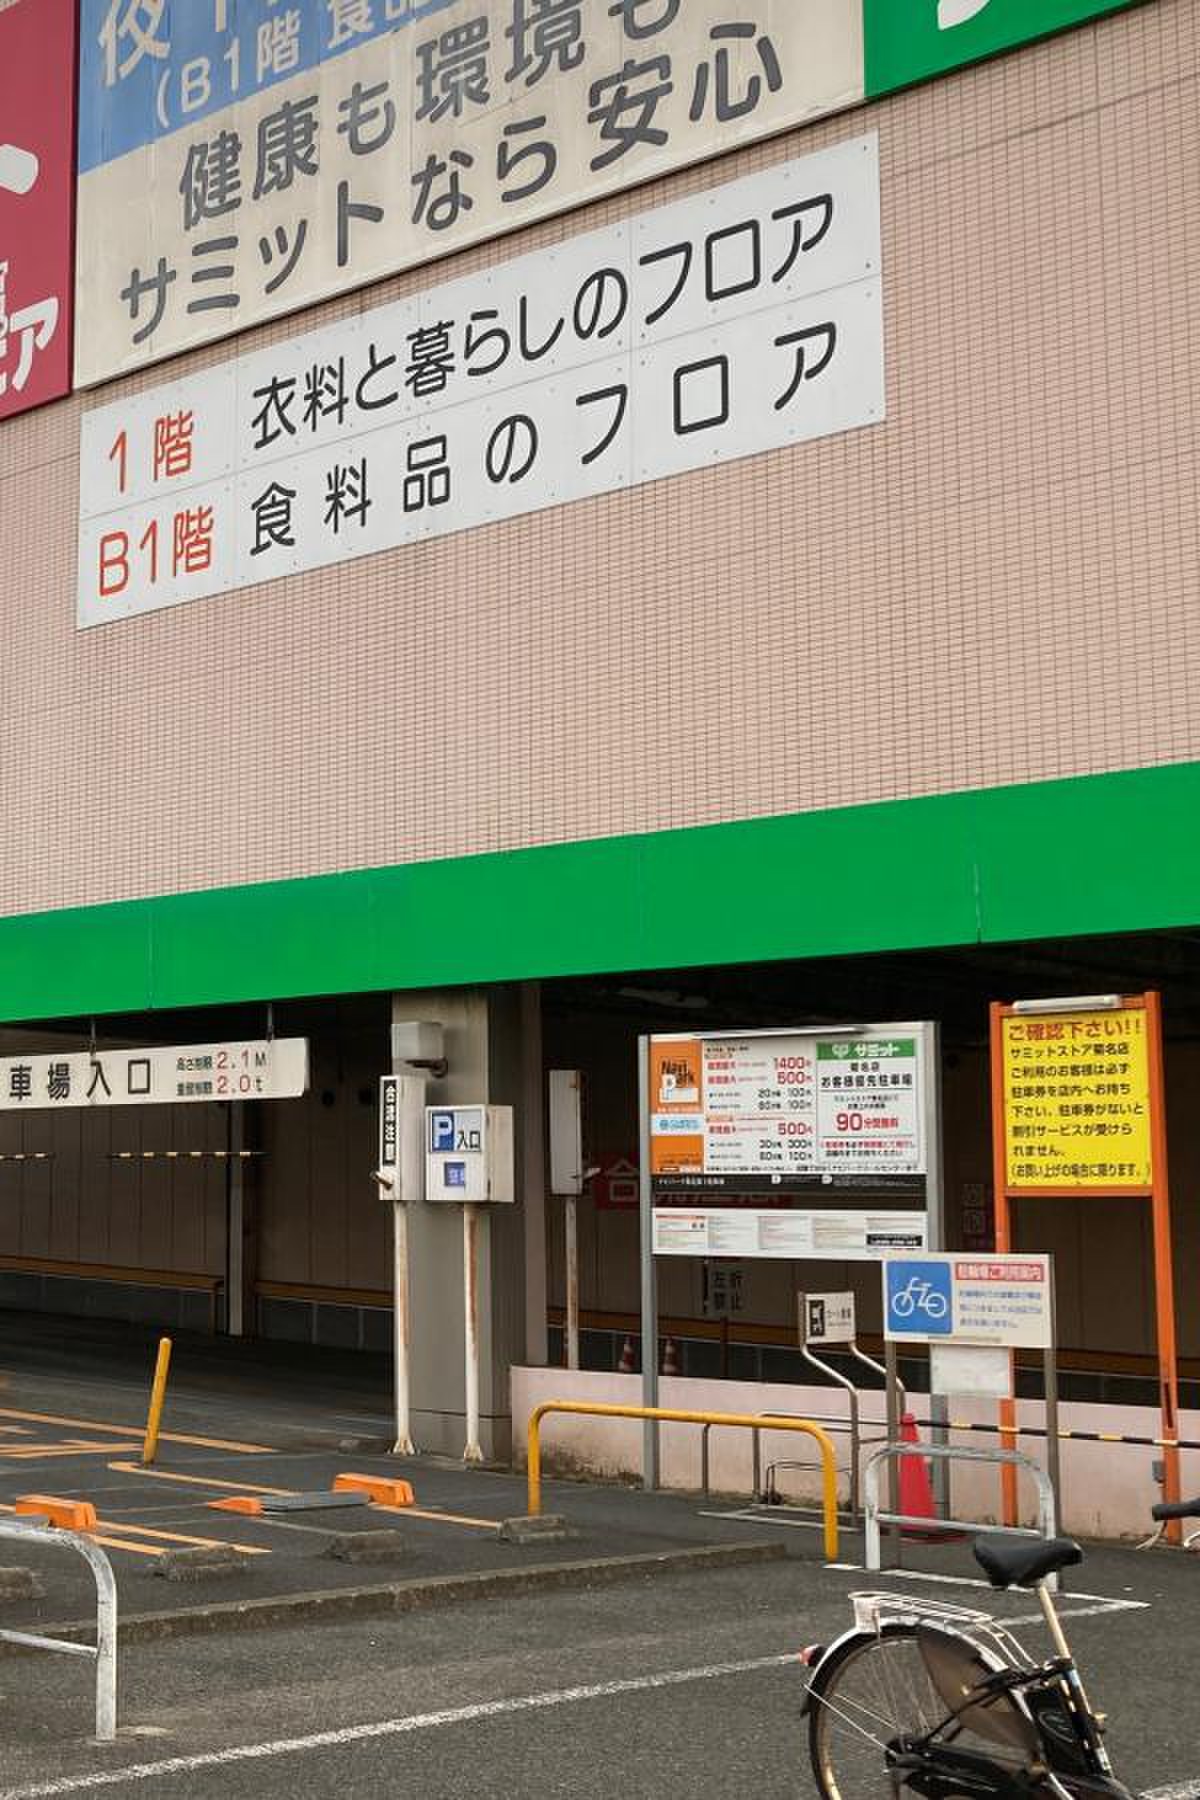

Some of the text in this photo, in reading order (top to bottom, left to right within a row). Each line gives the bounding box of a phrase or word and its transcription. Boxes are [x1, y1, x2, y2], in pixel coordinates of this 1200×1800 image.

[120, 22, 783, 344] サミットなら安心
[98, 321, 838, 598] B1階 食料品のフロア
[108, 193, 834, 493] 1階 衣料と暮らしのフロア
[432, 1114, 453, 1149] P
[456, 1130, 481, 1149] 入口
